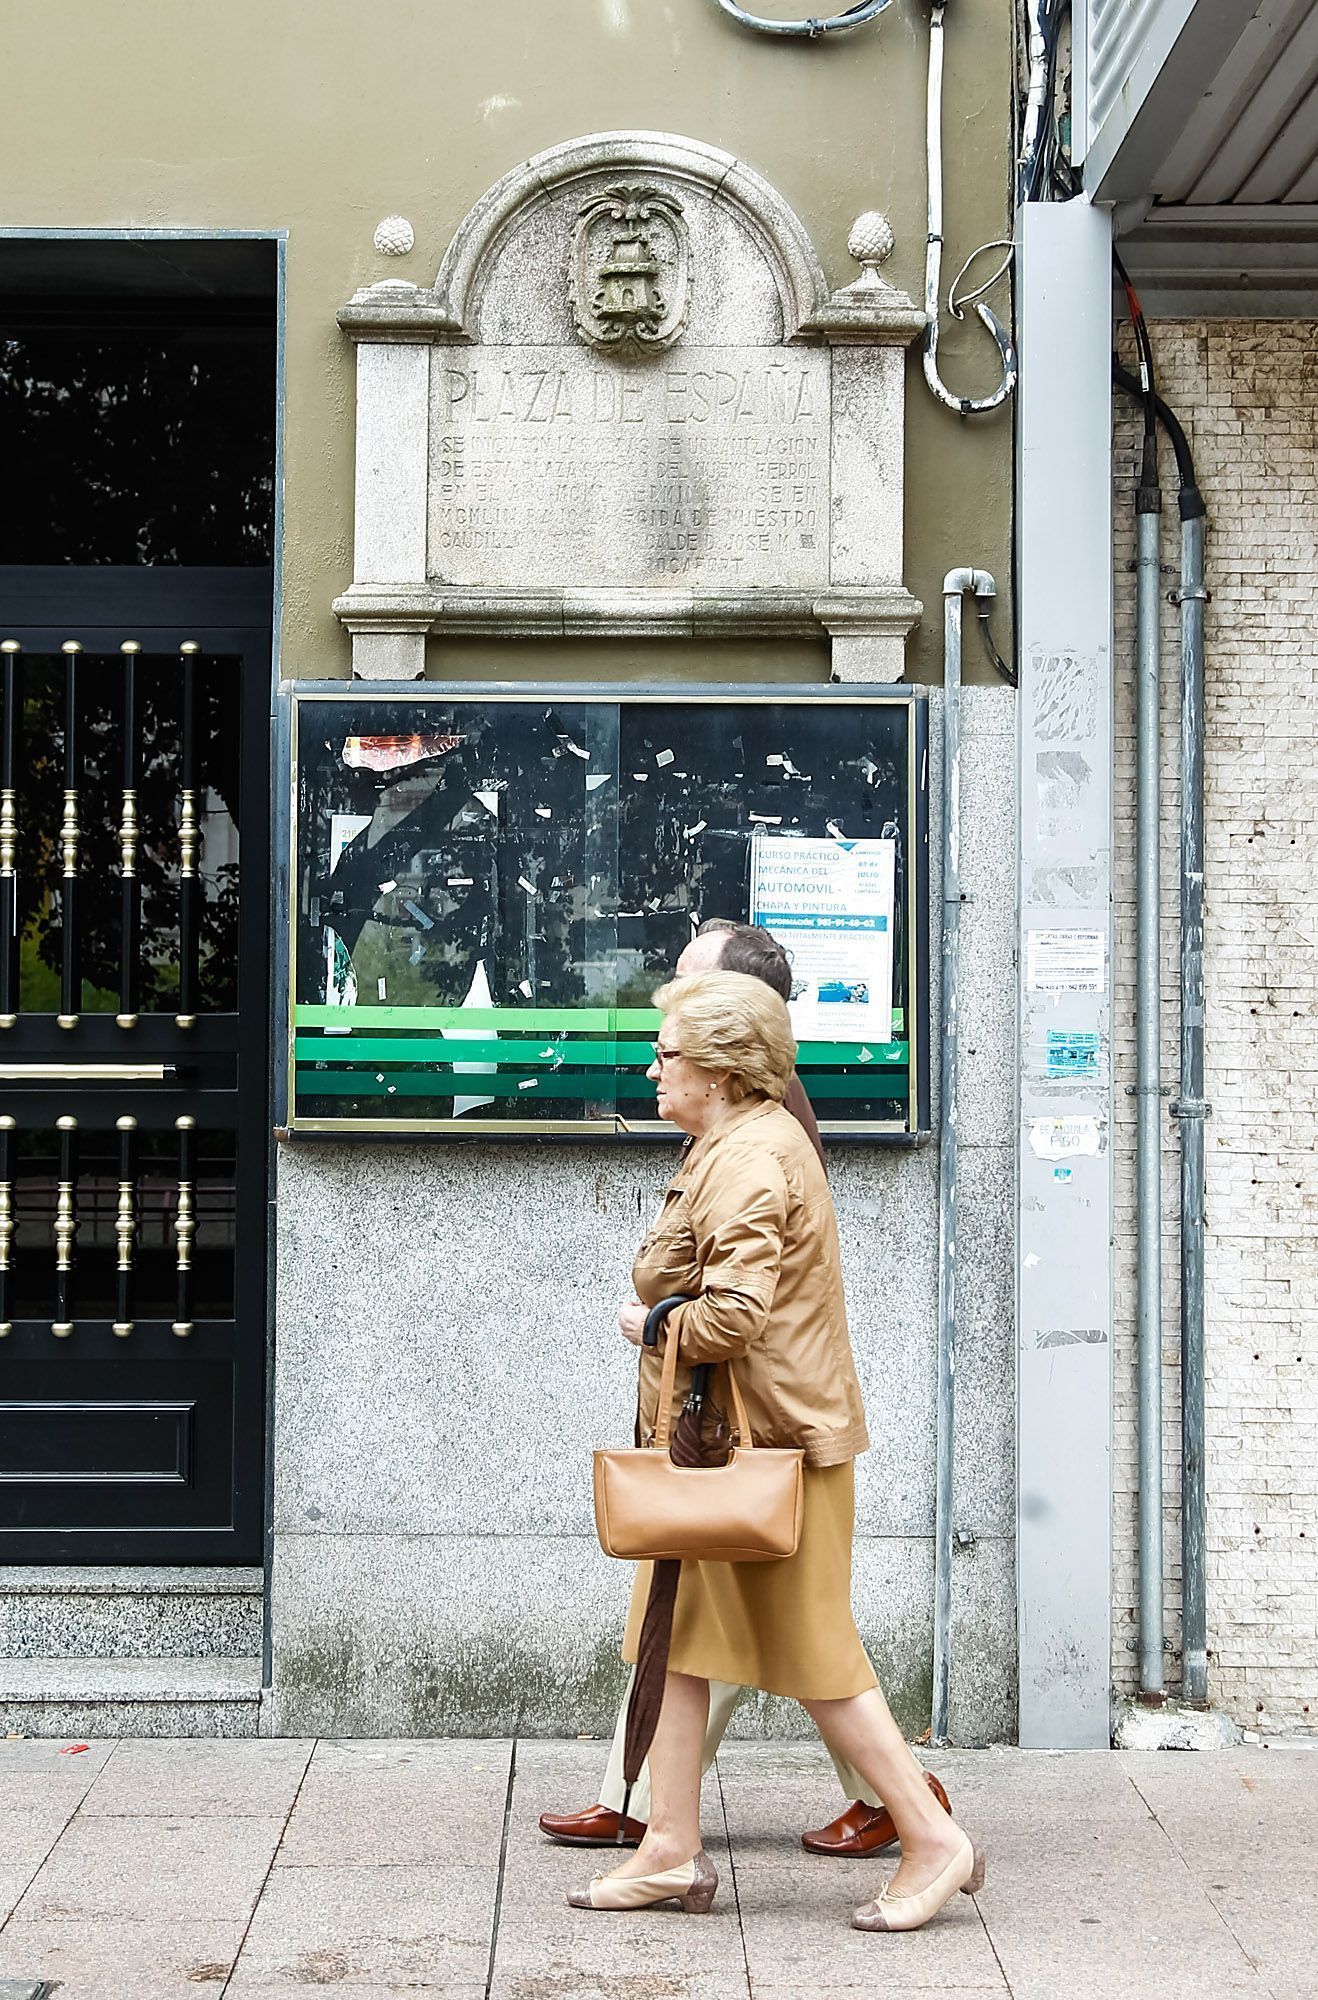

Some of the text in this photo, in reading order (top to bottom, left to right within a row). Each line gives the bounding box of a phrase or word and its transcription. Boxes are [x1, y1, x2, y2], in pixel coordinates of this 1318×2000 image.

[444, 364, 819, 424] PLAZA DE ESPAÑA
[441, 436, 464, 453] SE
[657, 437, 681, 455] DE
[441, 460, 464, 478] DE
[657, 461, 688, 479] DEL
[441, 484, 466, 501] EN
[476, 484, 500, 502] EL
[792, 485, 816, 503] EN
[692, 509, 717, 527] DE
[731, 510, 816, 527] NUESTRO
[759, 849, 840, 861] CURSO PRÁCTICO
[758, 865, 829, 876] MECÁNICA DEL
[757, 901, 791, 910] CHAPA
[802, 903, 847, 912] PINTURA
[788, 932, 837, 940] TOTALMENTE
[838, 931, 875, 941] PRÁCTICO
[1050, 1135, 1081, 1148] PSO
